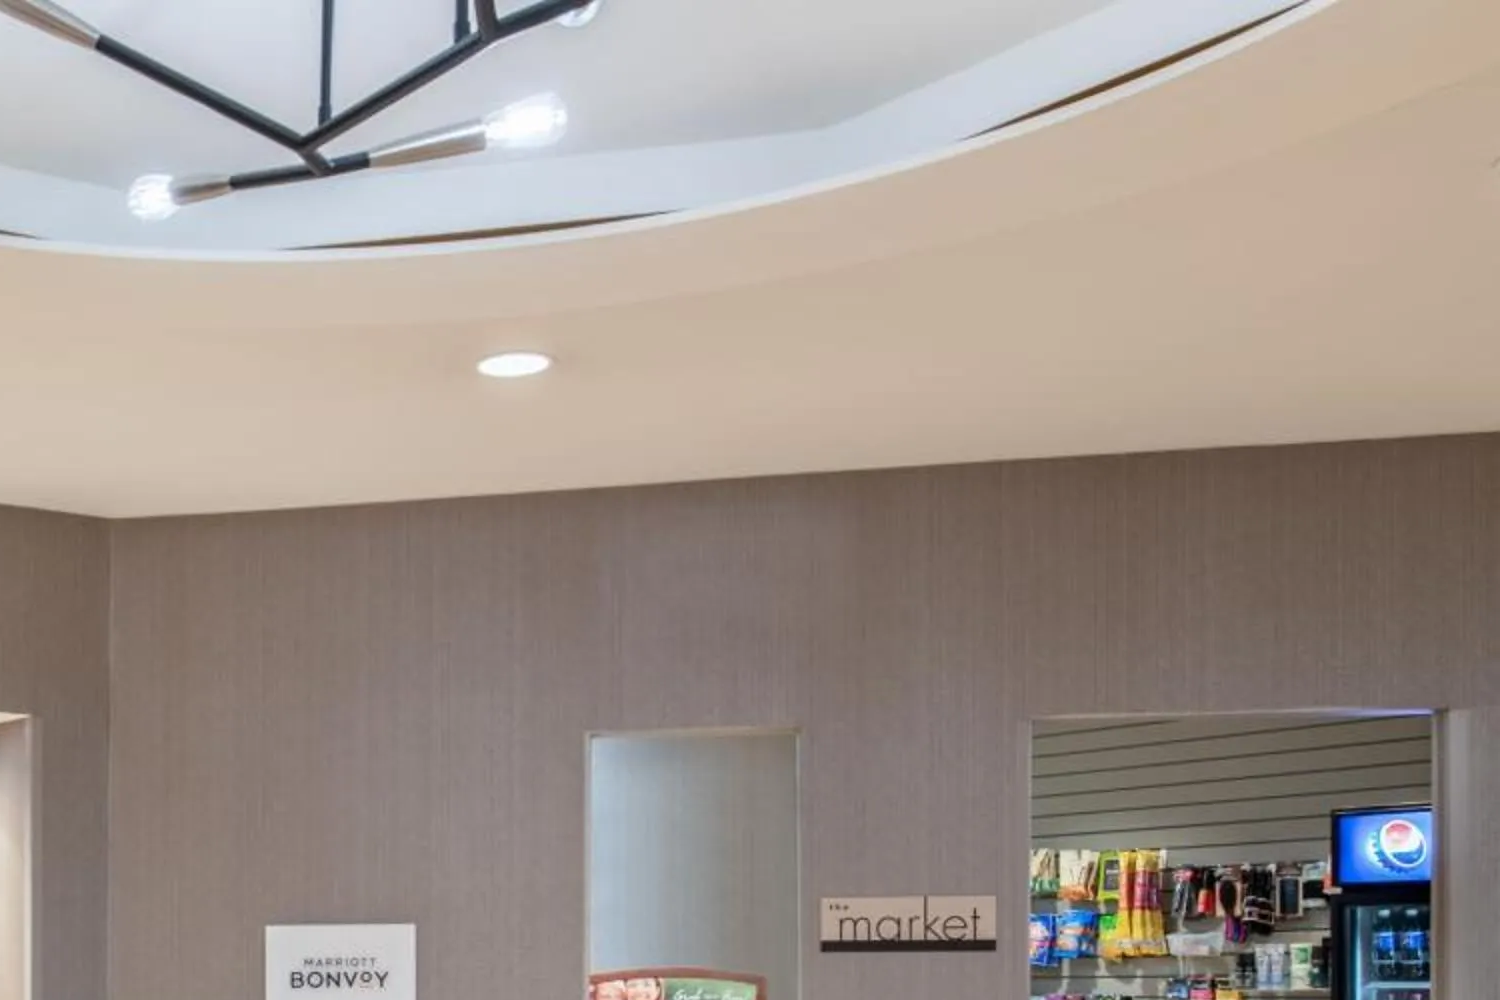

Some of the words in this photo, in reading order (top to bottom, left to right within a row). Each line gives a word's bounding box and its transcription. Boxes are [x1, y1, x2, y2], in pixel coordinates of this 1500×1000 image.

[838, 894, 981, 942] market
[303, 957, 377, 968] MARRIOTT
[290, 971, 389, 989] BONVOY
